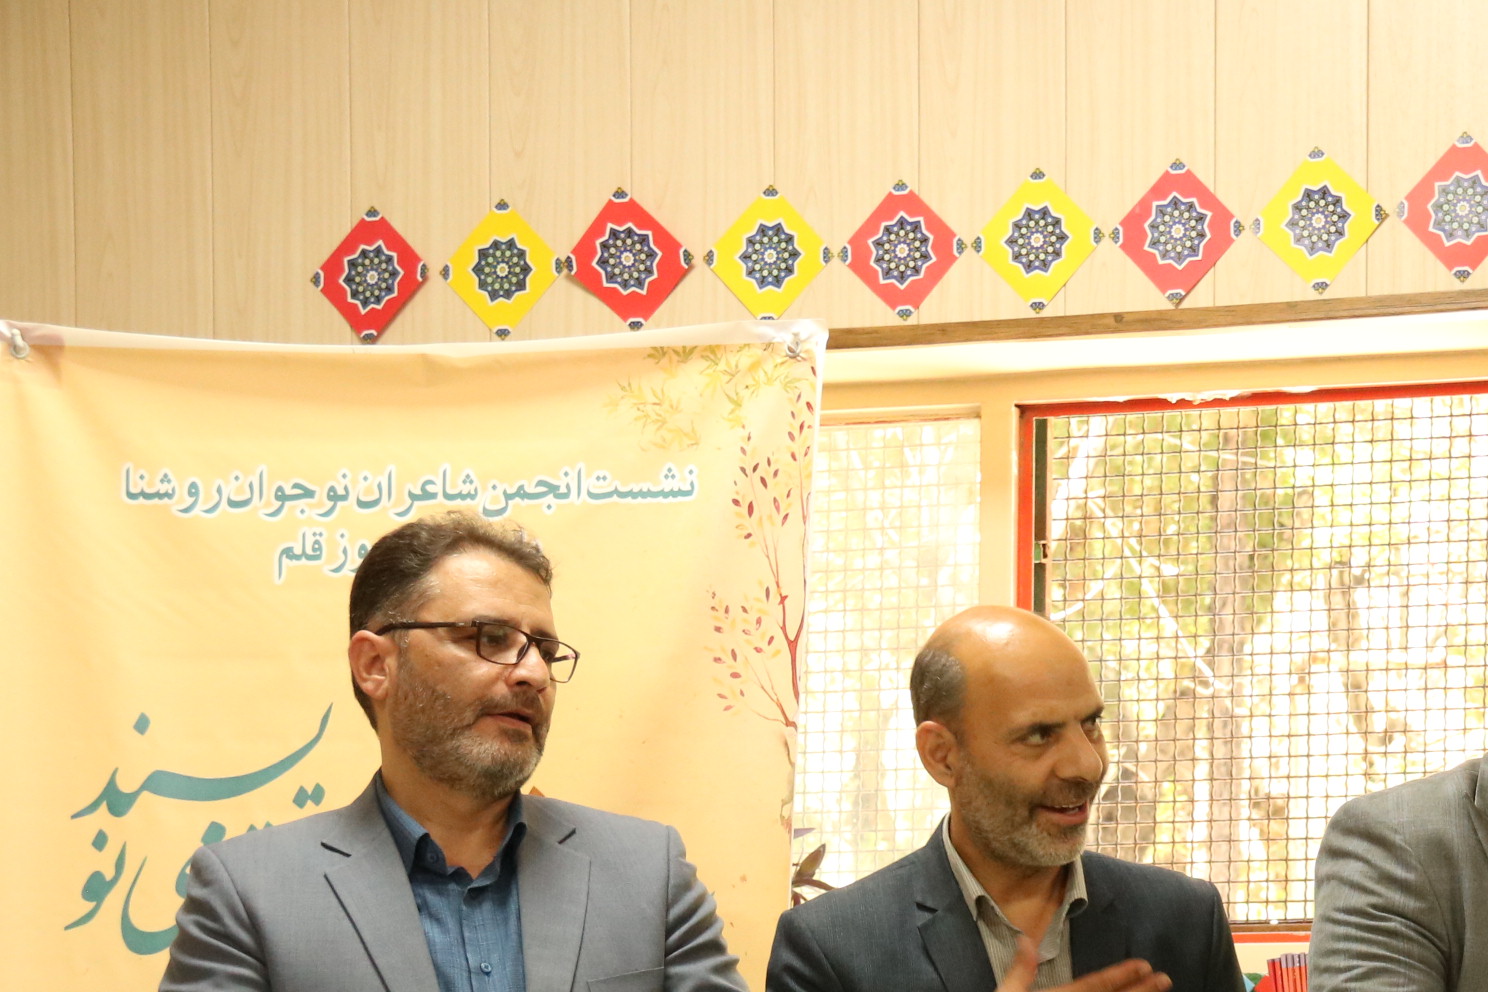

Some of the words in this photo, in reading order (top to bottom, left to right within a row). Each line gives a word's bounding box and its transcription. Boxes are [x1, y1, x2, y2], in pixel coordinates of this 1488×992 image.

[125, 466, 223, 514] روشنا
[226, 469, 350, 518] نوجوان
[356, 466, 479, 518] شاعران
[482, 466, 582, 518] انجمن
[586, 466, 696, 501] نشست
[278, 531, 324, 581] قلم
